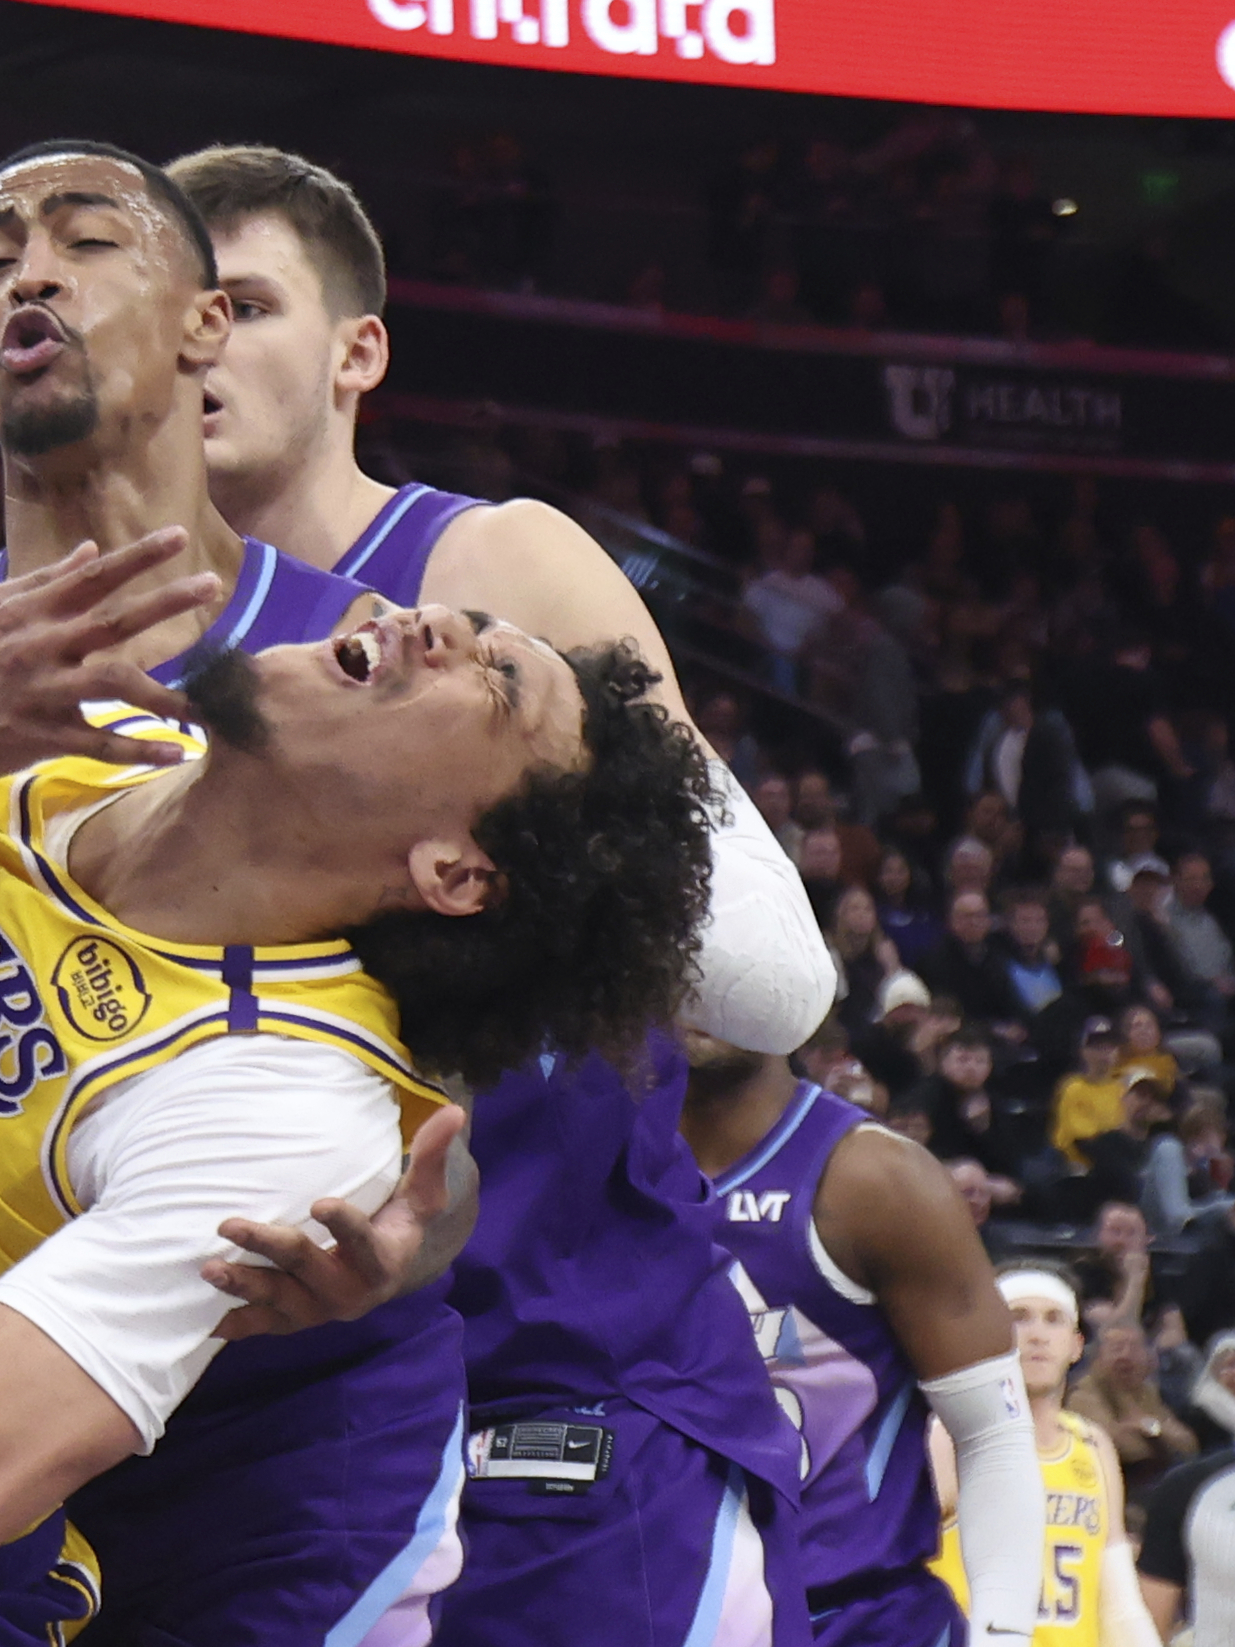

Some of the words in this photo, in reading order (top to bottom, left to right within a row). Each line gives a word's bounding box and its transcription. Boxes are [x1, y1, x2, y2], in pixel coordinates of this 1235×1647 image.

[968, 385, 1122, 431] HEALTH
[77, 943, 128, 1031] bibigo
[728, 1191, 791, 1222] LVT
